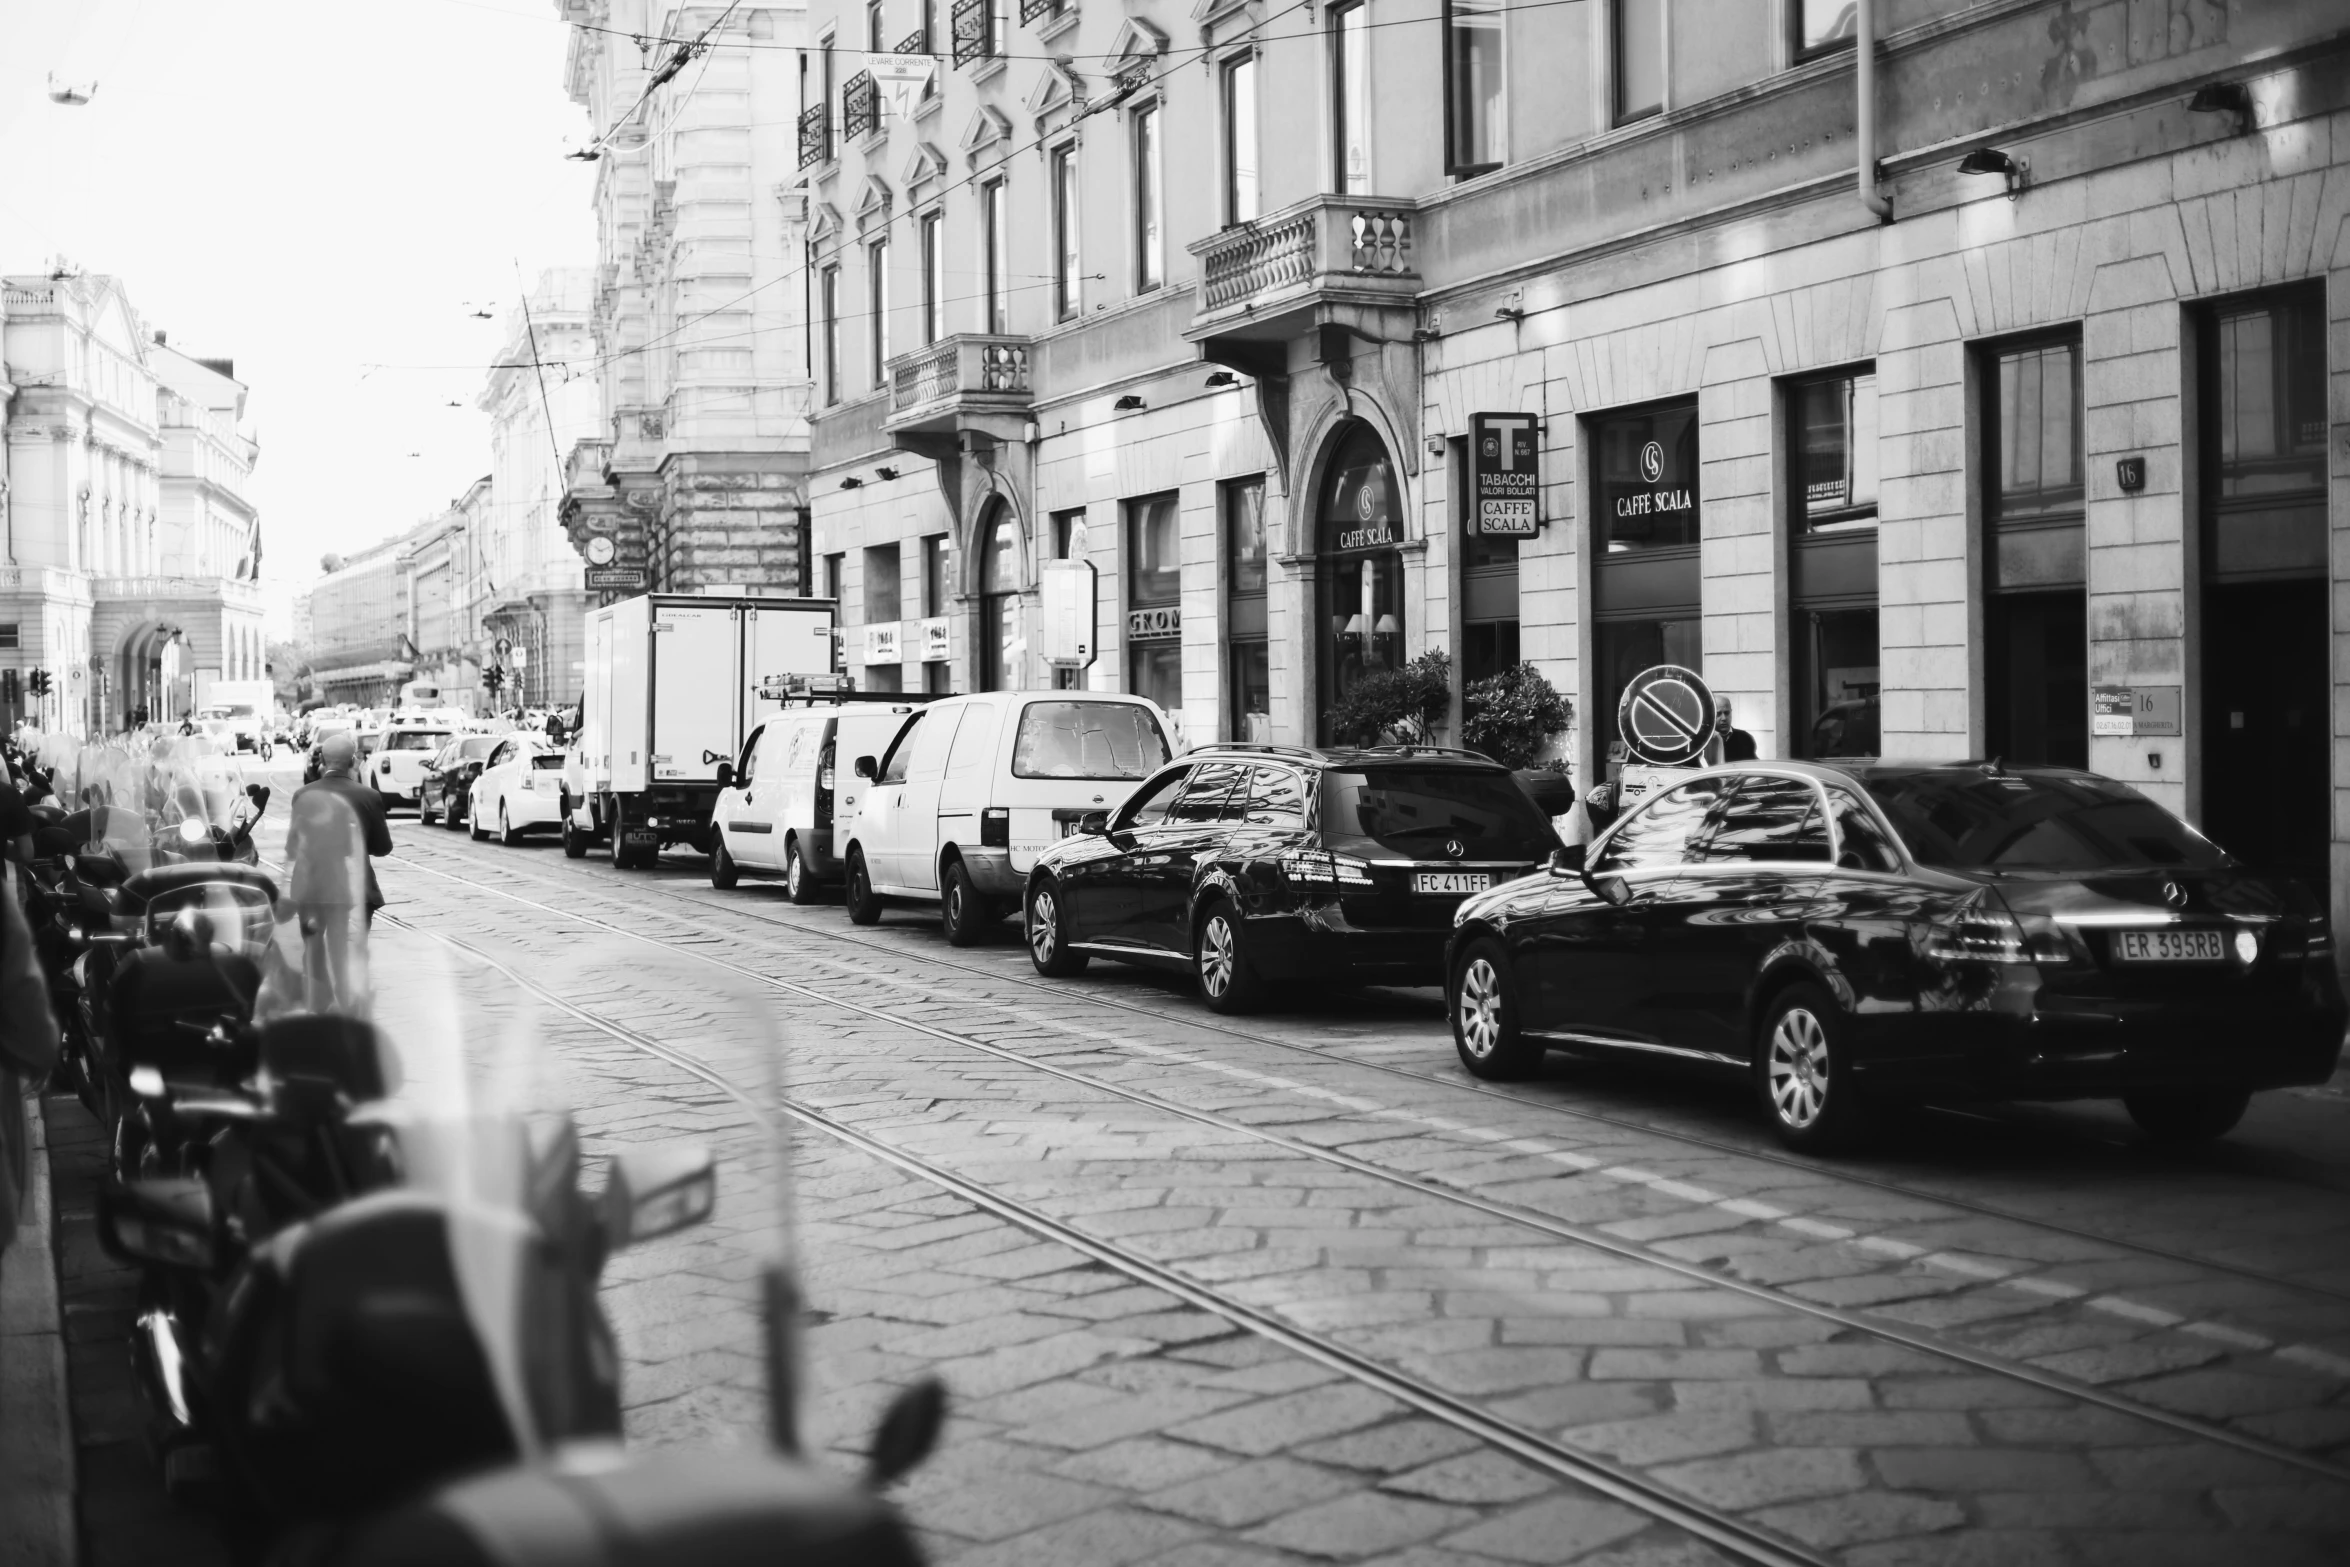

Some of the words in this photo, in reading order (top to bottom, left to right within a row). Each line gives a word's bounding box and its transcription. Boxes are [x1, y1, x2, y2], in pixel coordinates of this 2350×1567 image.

[868, 57, 894, 65] LEVARE
[895, 58, 933, 67] CORRENTE
[1484, 419, 1529, 470] T
[1480, 474, 1535, 486] TABACCHI
[2120, 464, 2136, 485] 16
[1481, 487, 1504, 495] VALORI
[1507, 487, 1535, 495] BOLLATI
[1655, 489, 1692, 512] SCALA
[1483, 518, 1531, 531] SCALA
[1367, 527, 1393, 545] SCALA
[2095, 693, 2120, 703] Affittasi
[2140, 694, 2154, 712] 16
[2095, 703, 2112, 713] Uffici
[2138, 721, 2174, 729] MARGHERITA
[1420, 875, 1439, 891] FC
[2125, 933, 2152, 958] ER
[2156, 932, 2221, 958] 395RB
